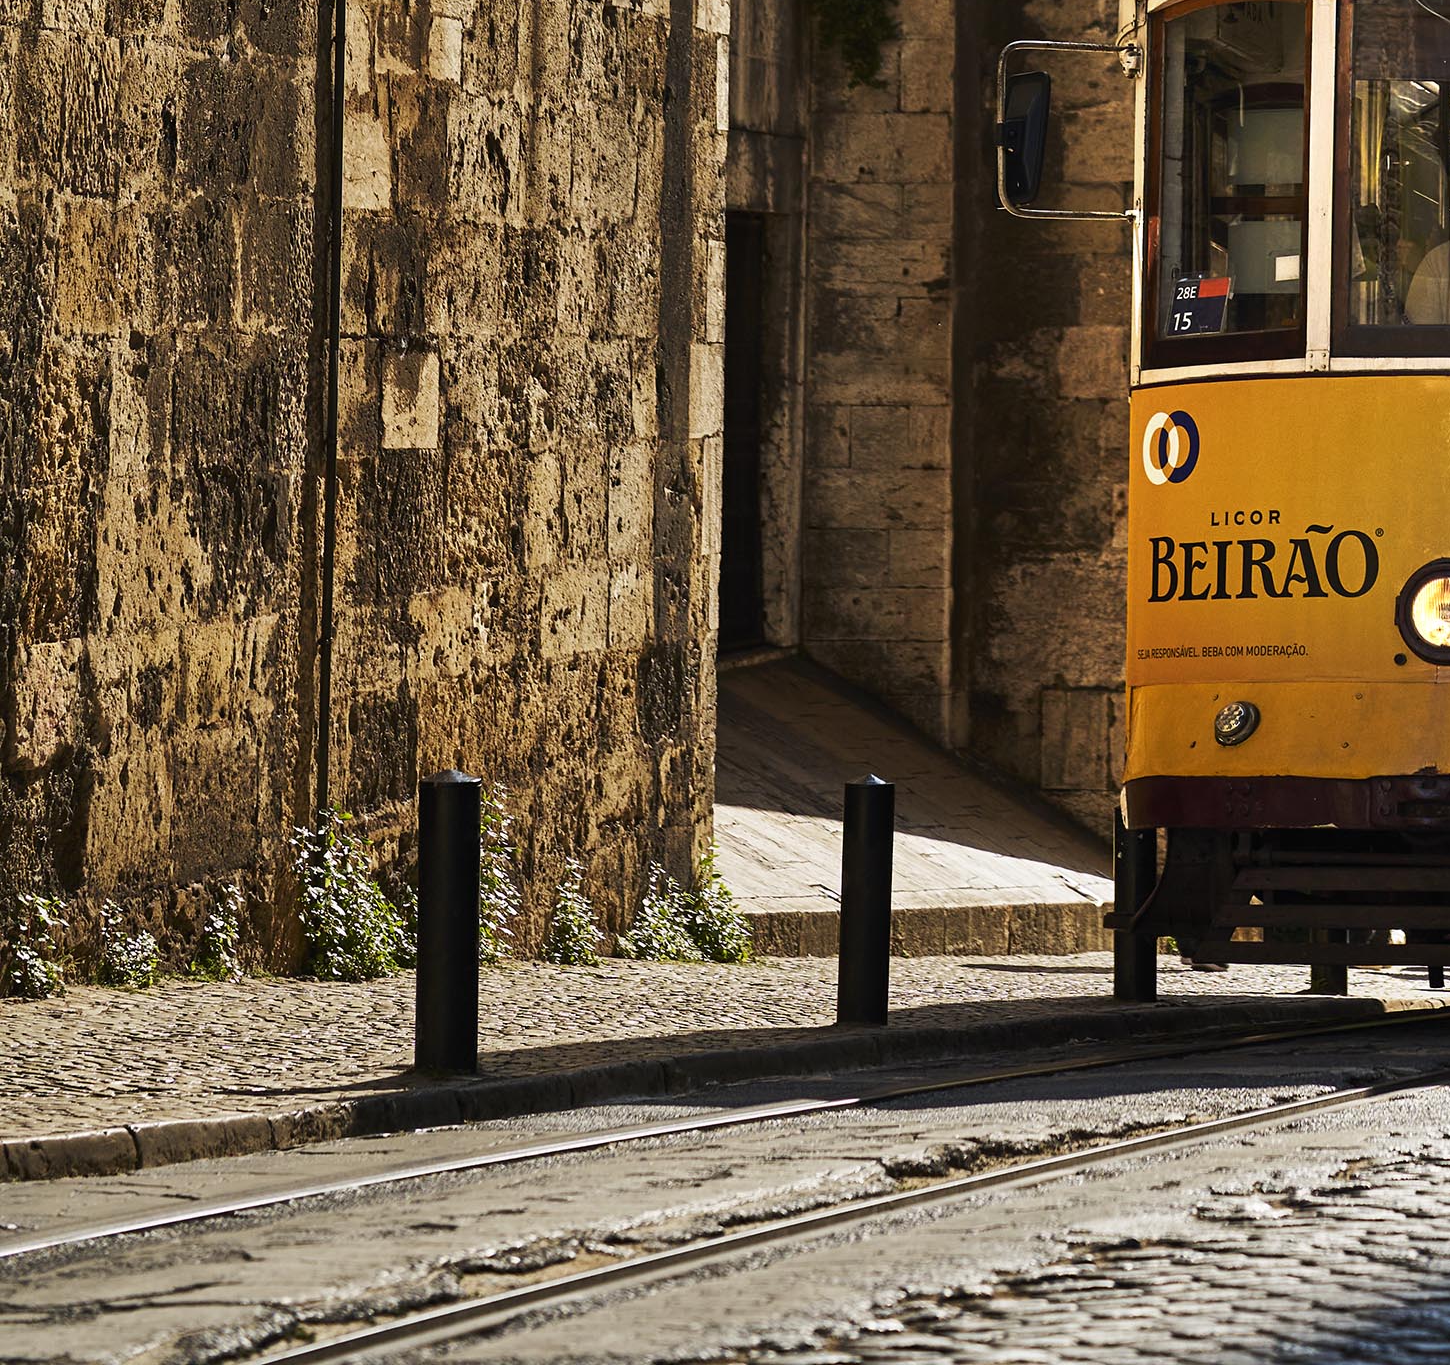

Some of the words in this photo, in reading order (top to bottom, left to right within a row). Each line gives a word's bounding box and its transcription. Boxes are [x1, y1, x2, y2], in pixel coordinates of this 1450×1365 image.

[1176, 286, 1197, 300] 28E
[1173, 312, 1193, 331] 15
[1211, 510, 1281, 526] LICOR
[1137, 649, 1150, 660] SEJA
[1151, 644, 1200, 659] RESPONSÁVEL.
[1202, 646, 1224, 658] BEBA
[1225, 645, 1244, 657] COM
[1245, 643, 1309, 659] MODERAÇÃO.
